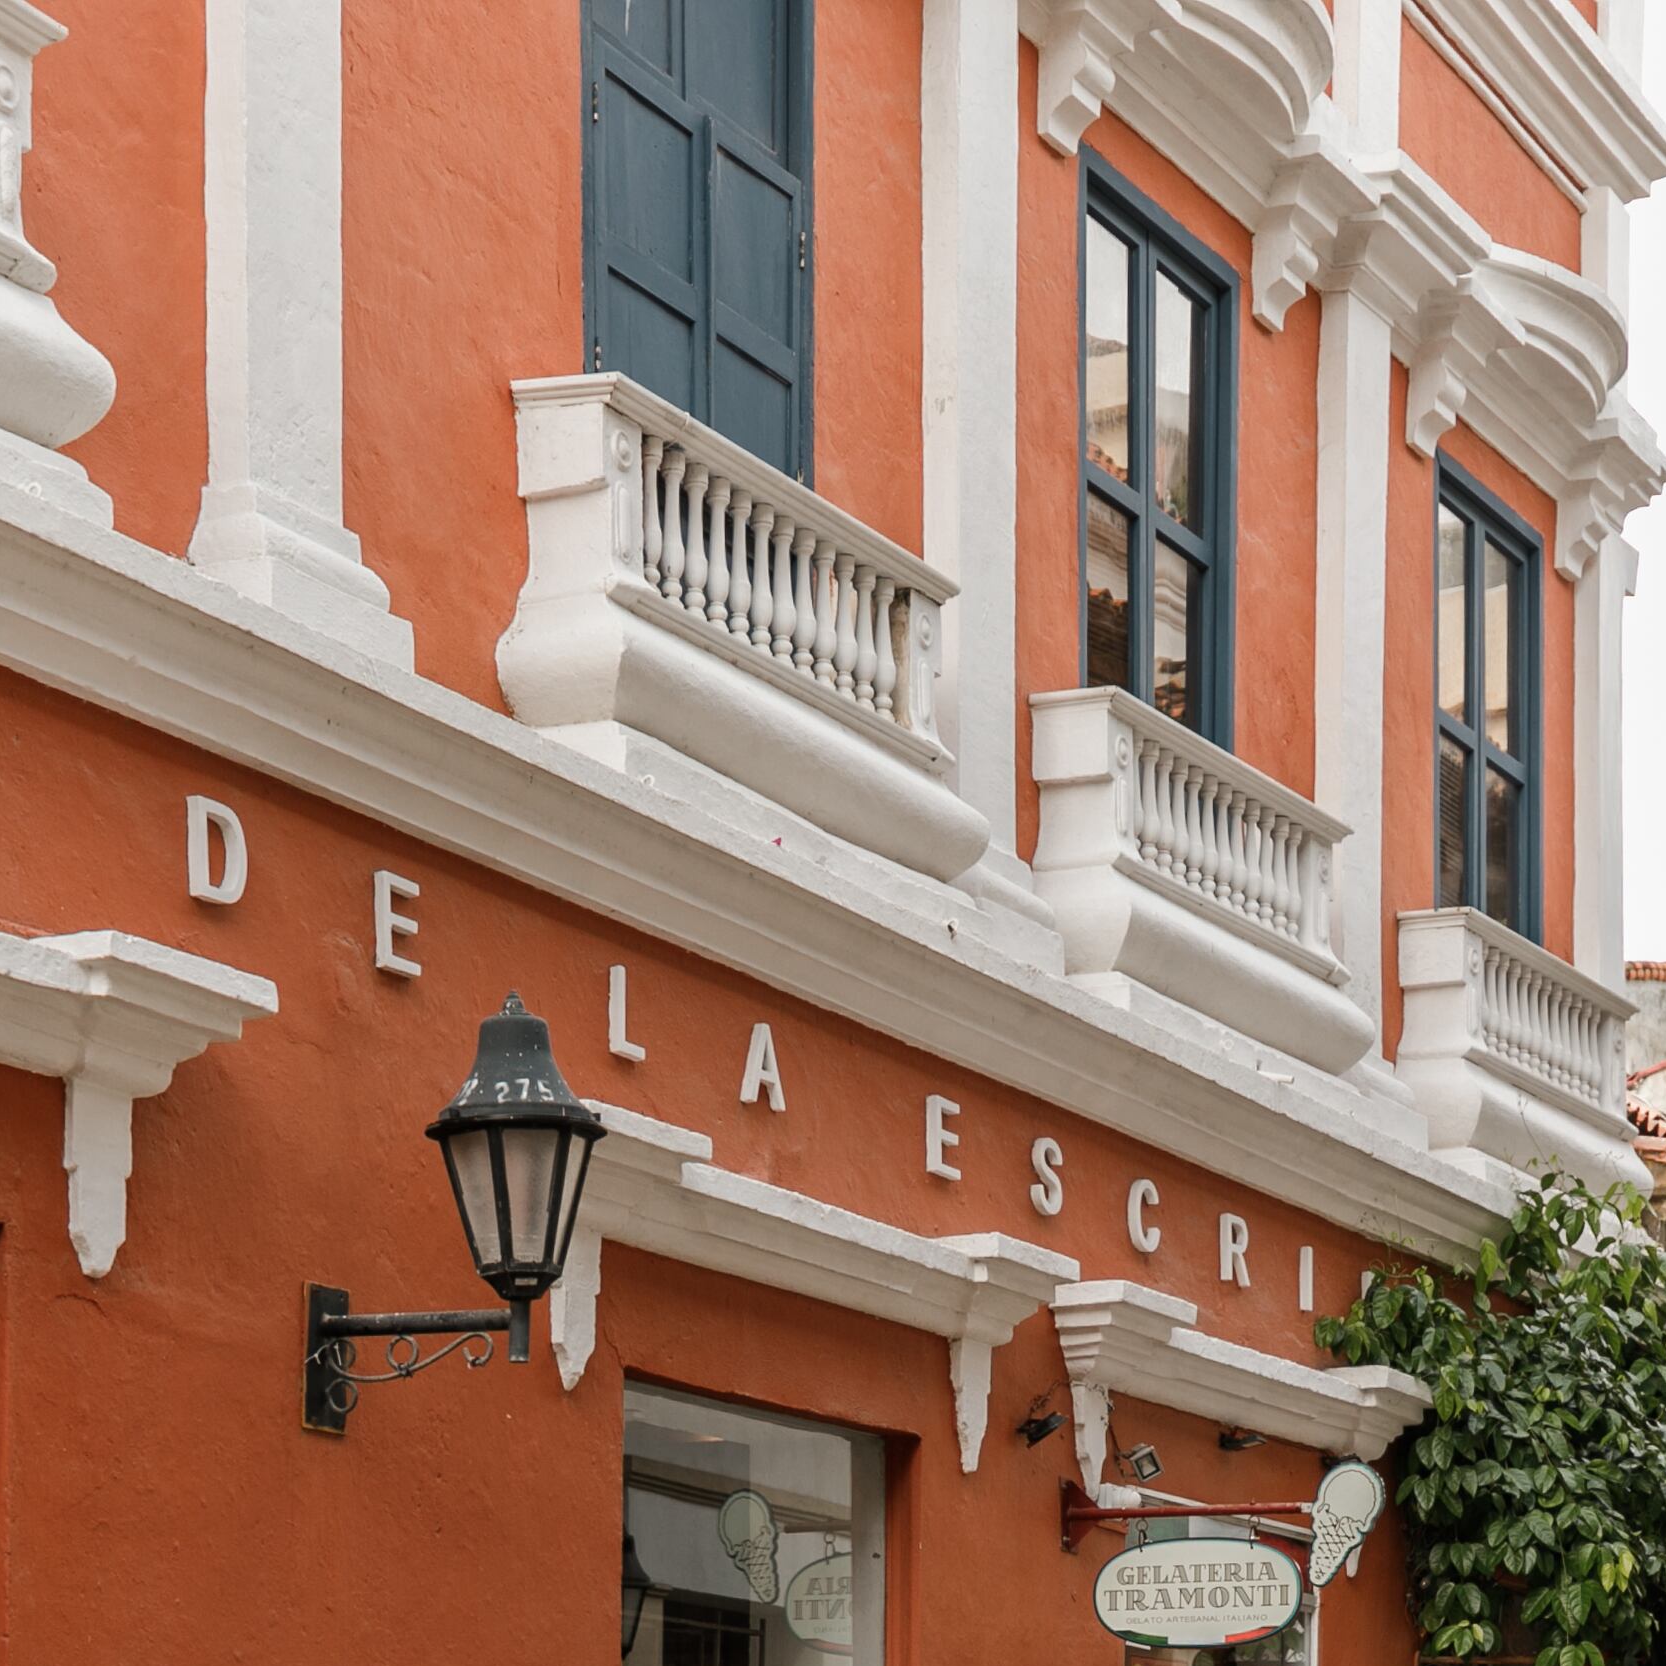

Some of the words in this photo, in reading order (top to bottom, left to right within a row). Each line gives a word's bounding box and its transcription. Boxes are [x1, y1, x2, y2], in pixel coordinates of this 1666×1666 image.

[186, 794, 422, 979] DE
[608, 964, 786, 1113] LA
[926, 1093, 1375, 1312] ESCRI
[494, 1077, 555, 1104] 275
[1116, 1561, 1279, 1586] GELATERIA
[1103, 1584, 1291, 1612] TRAMONTI
[1125, 1616, 1164, 1625] GELATO
[1166, 1615, 1221, 1624] ARTESANAL
[1222, 1613, 1269, 1622] ITALIANO
